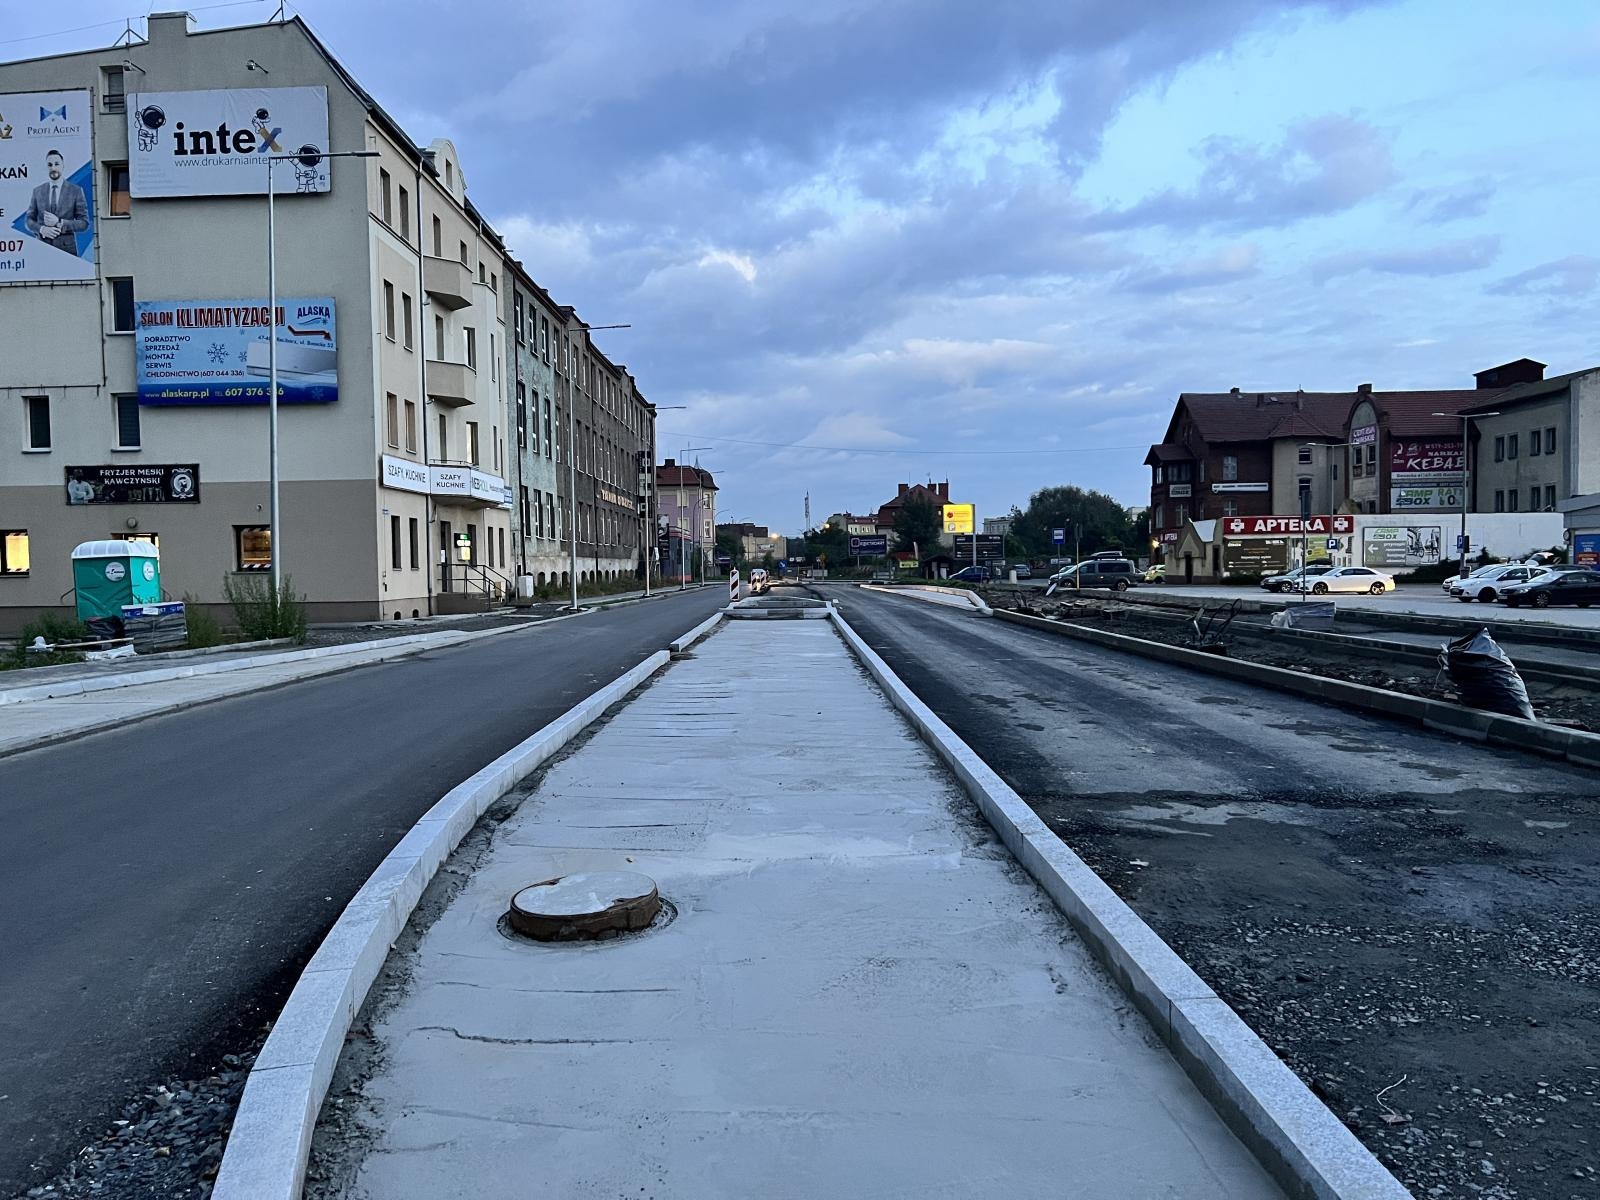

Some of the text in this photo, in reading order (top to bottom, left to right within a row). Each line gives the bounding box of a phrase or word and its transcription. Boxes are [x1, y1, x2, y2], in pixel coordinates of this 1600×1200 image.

[53, 125, 80, 134] AGENT
[174, 121, 283, 156] intex
[174, 155, 284, 168] www.drukarniainte.pl
[297, 306, 330, 319] ALASKA
[141, 306, 285, 329] SALON KLIMATYZACJI
[144, 335, 191, 343] DORADZTWO
[145, 343, 180, 352] SPRZEDAŻ
[145, 352, 175, 360] MONTAŻ
[224, 388, 243, 397] 607
[246, 388, 264, 396] 376
[266, 387, 284, 396] 36
[1407, 456, 1464, 470] KEBAB
[100, 469, 136, 477] FRYZJER
[436, 481, 466, 489] KUCHNIE
[1254, 518, 1325, 532] APTEKA
[1328, 540, 1336, 548] P
